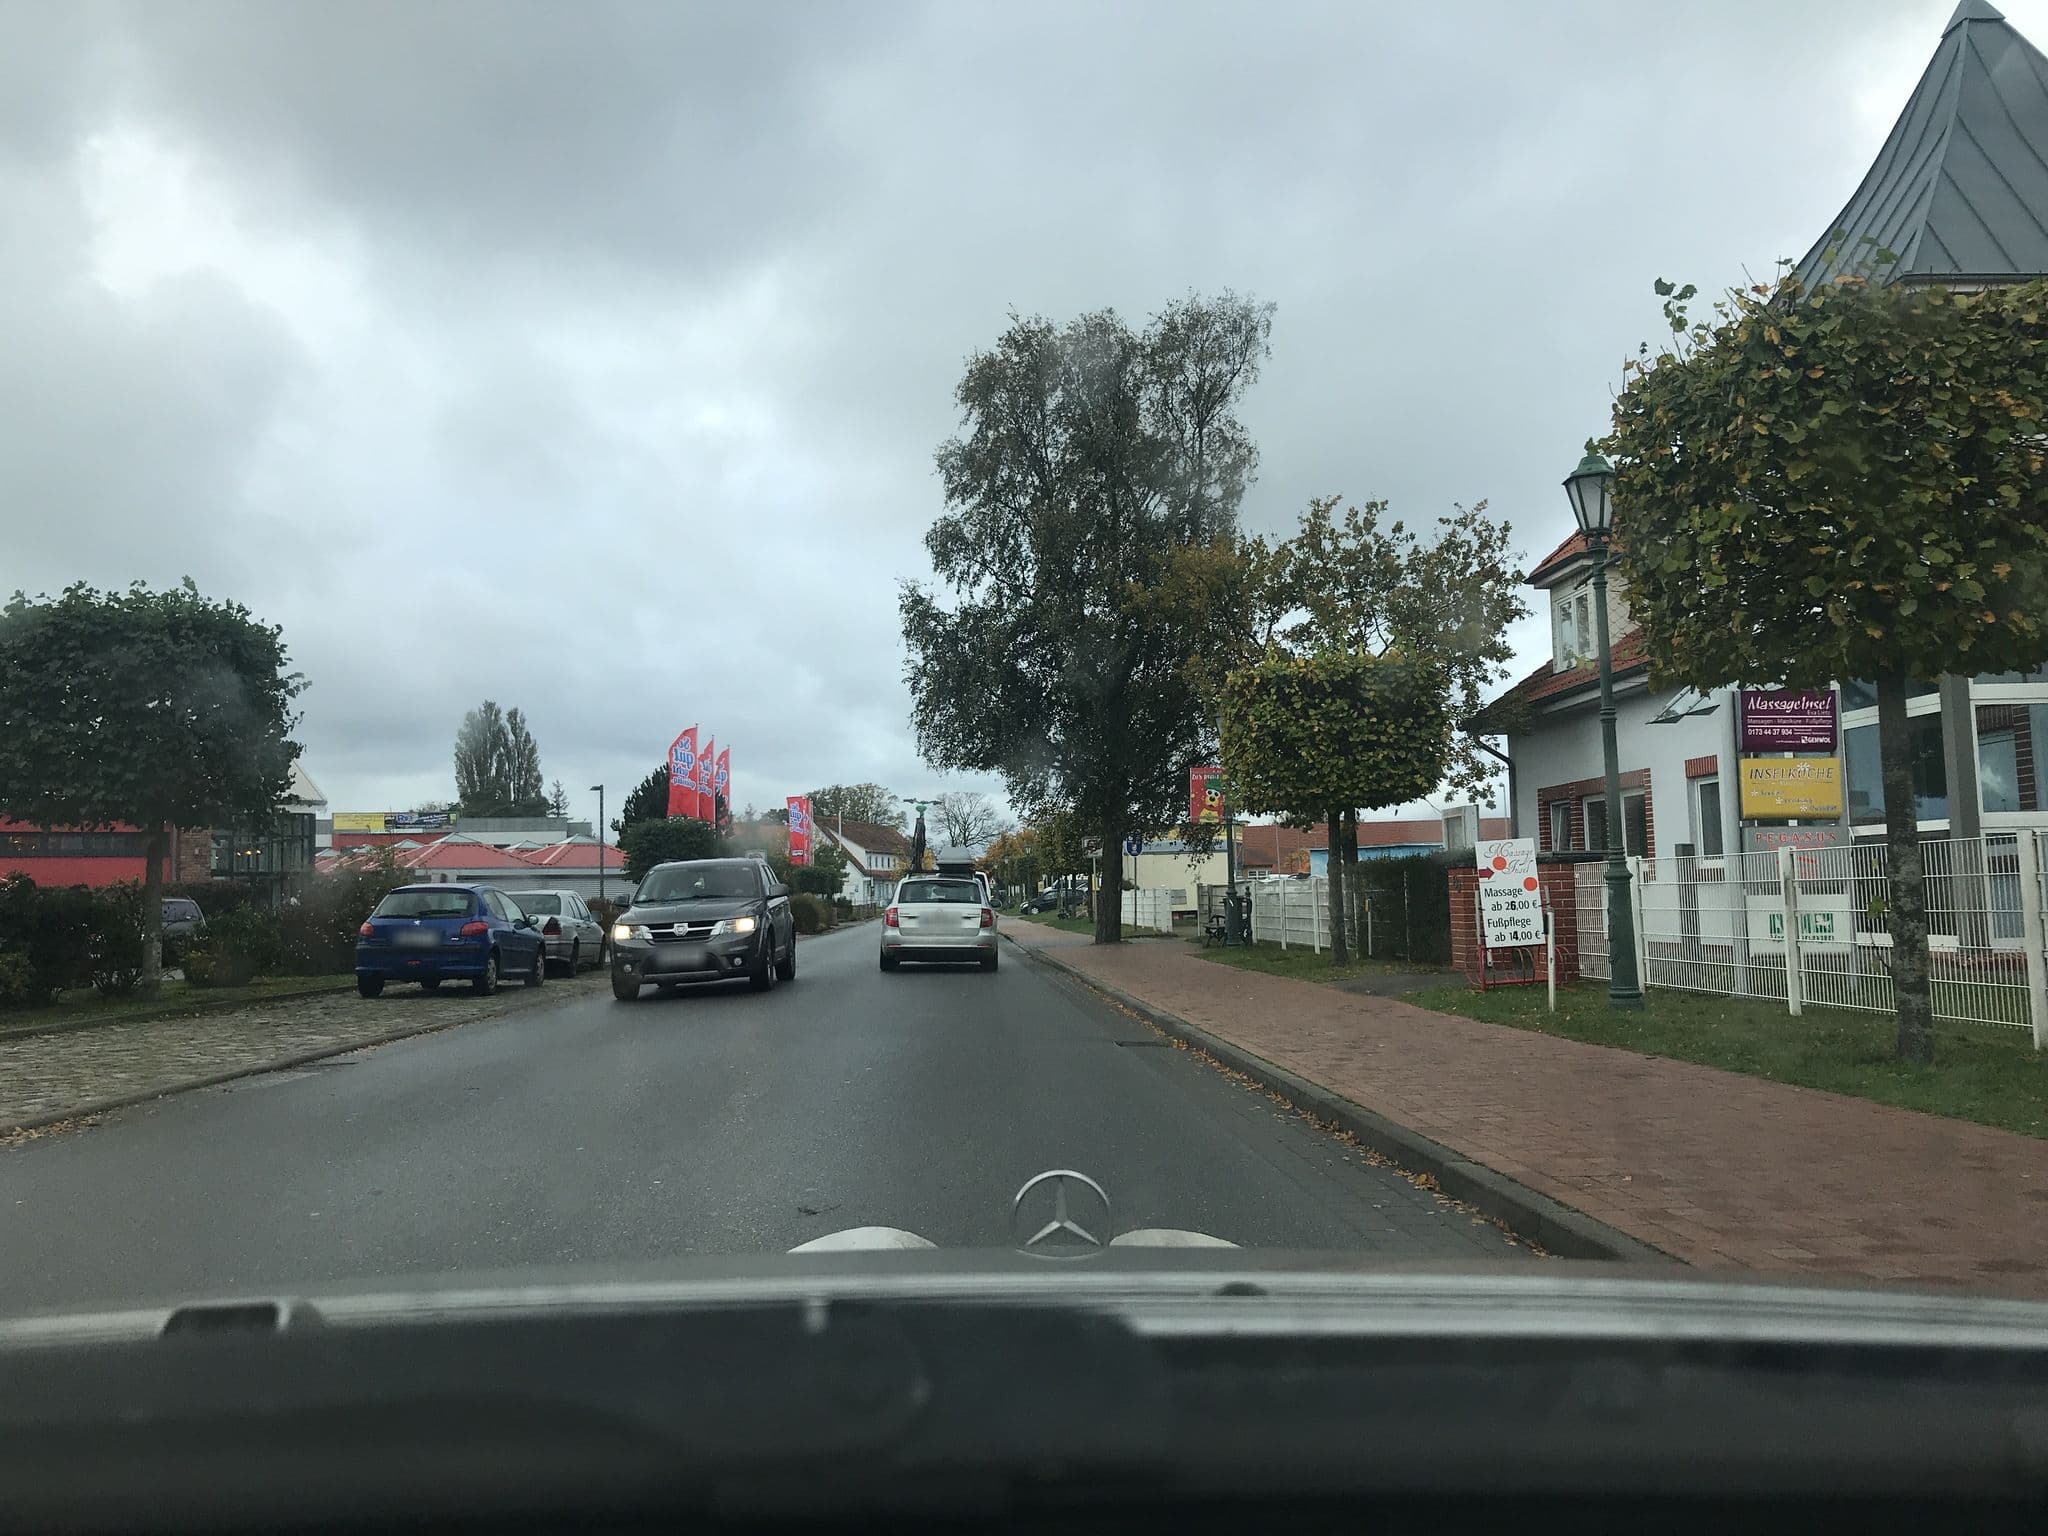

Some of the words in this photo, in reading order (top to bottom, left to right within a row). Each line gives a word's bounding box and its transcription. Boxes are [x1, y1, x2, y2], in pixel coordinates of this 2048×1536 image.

[1747, 728, 1763, 736] 0173
[1763, 728, 1772, 736] 44
[1772, 728, 1780, 736] 37
[1755, 832, 1837, 843] PEGASUS
[1484, 887, 1524, 899] Massage
[1491, 901, 1503, 911] ab
[1505, 900, 1530, 911] 26,00
[1532, 899, 1538, 909] €
[1487, 916, 1532, 930] Fußpflege
[1494, 931, 1506, 942] ab
[1509, 930, 1533, 942] 14,00
[1535, 930, 1541, 940] €
